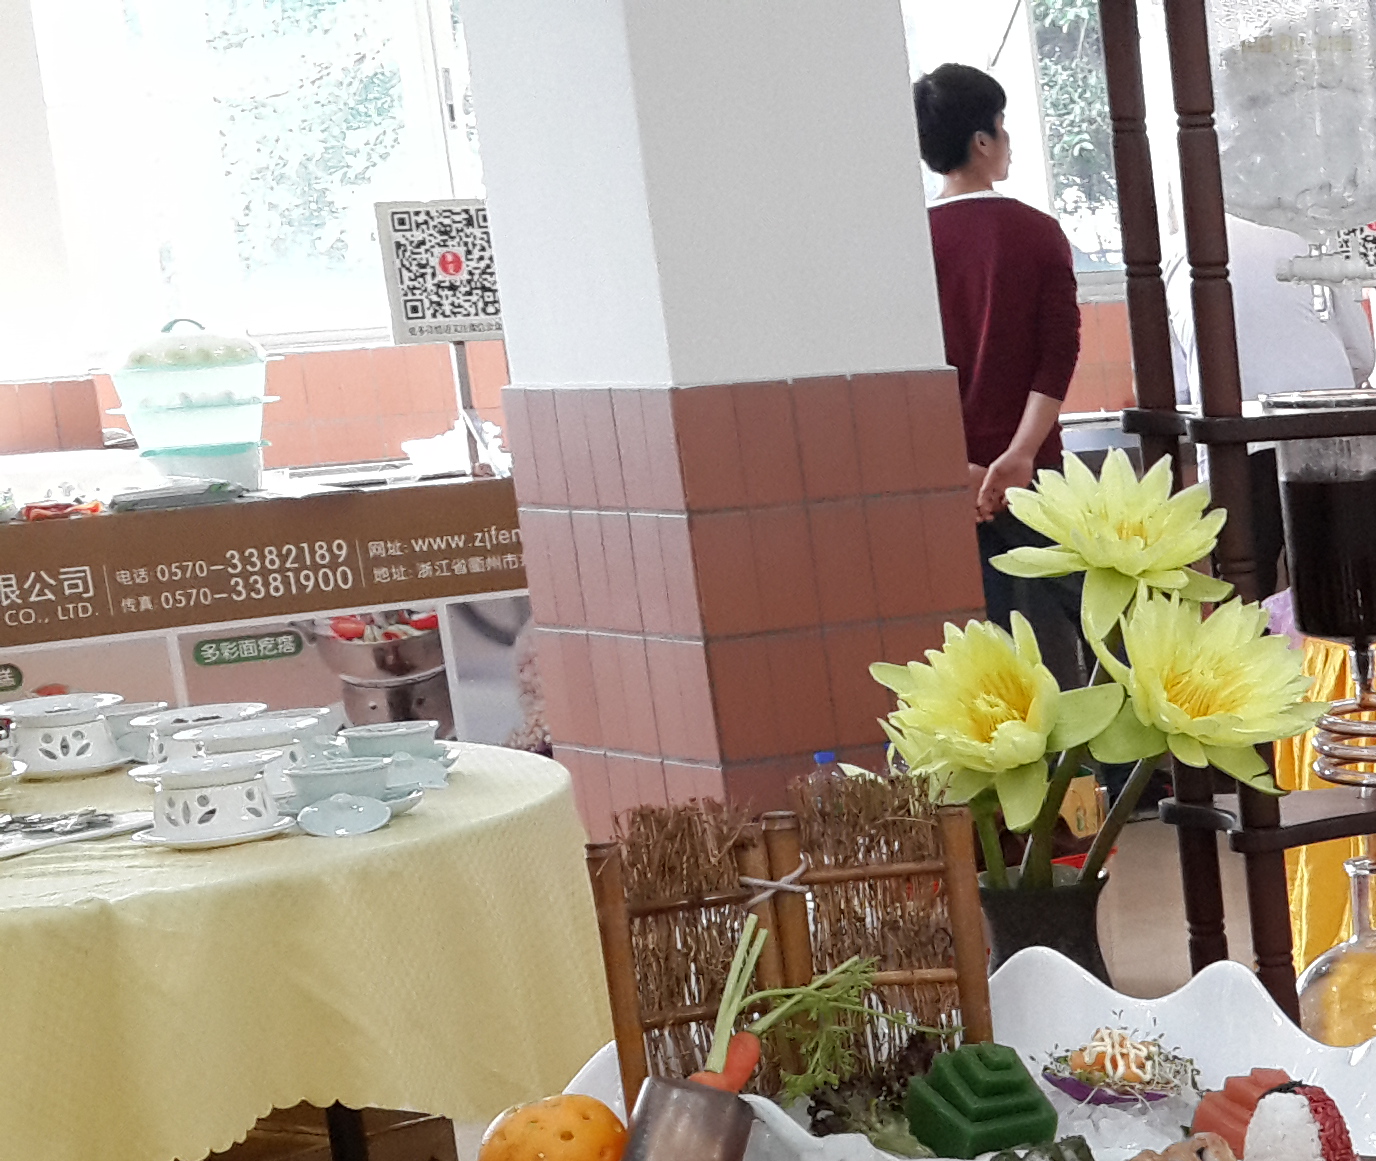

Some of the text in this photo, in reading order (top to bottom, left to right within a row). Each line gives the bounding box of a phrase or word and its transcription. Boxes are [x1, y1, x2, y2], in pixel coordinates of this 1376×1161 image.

[116, 539, 348, 585] 电话 0570-3382189
[417, 553, 526, 579] 浙江省衢州市
[121, 566, 353, 613] 传真 0570-3381900
[57, 602, 99, 621] LTD.
